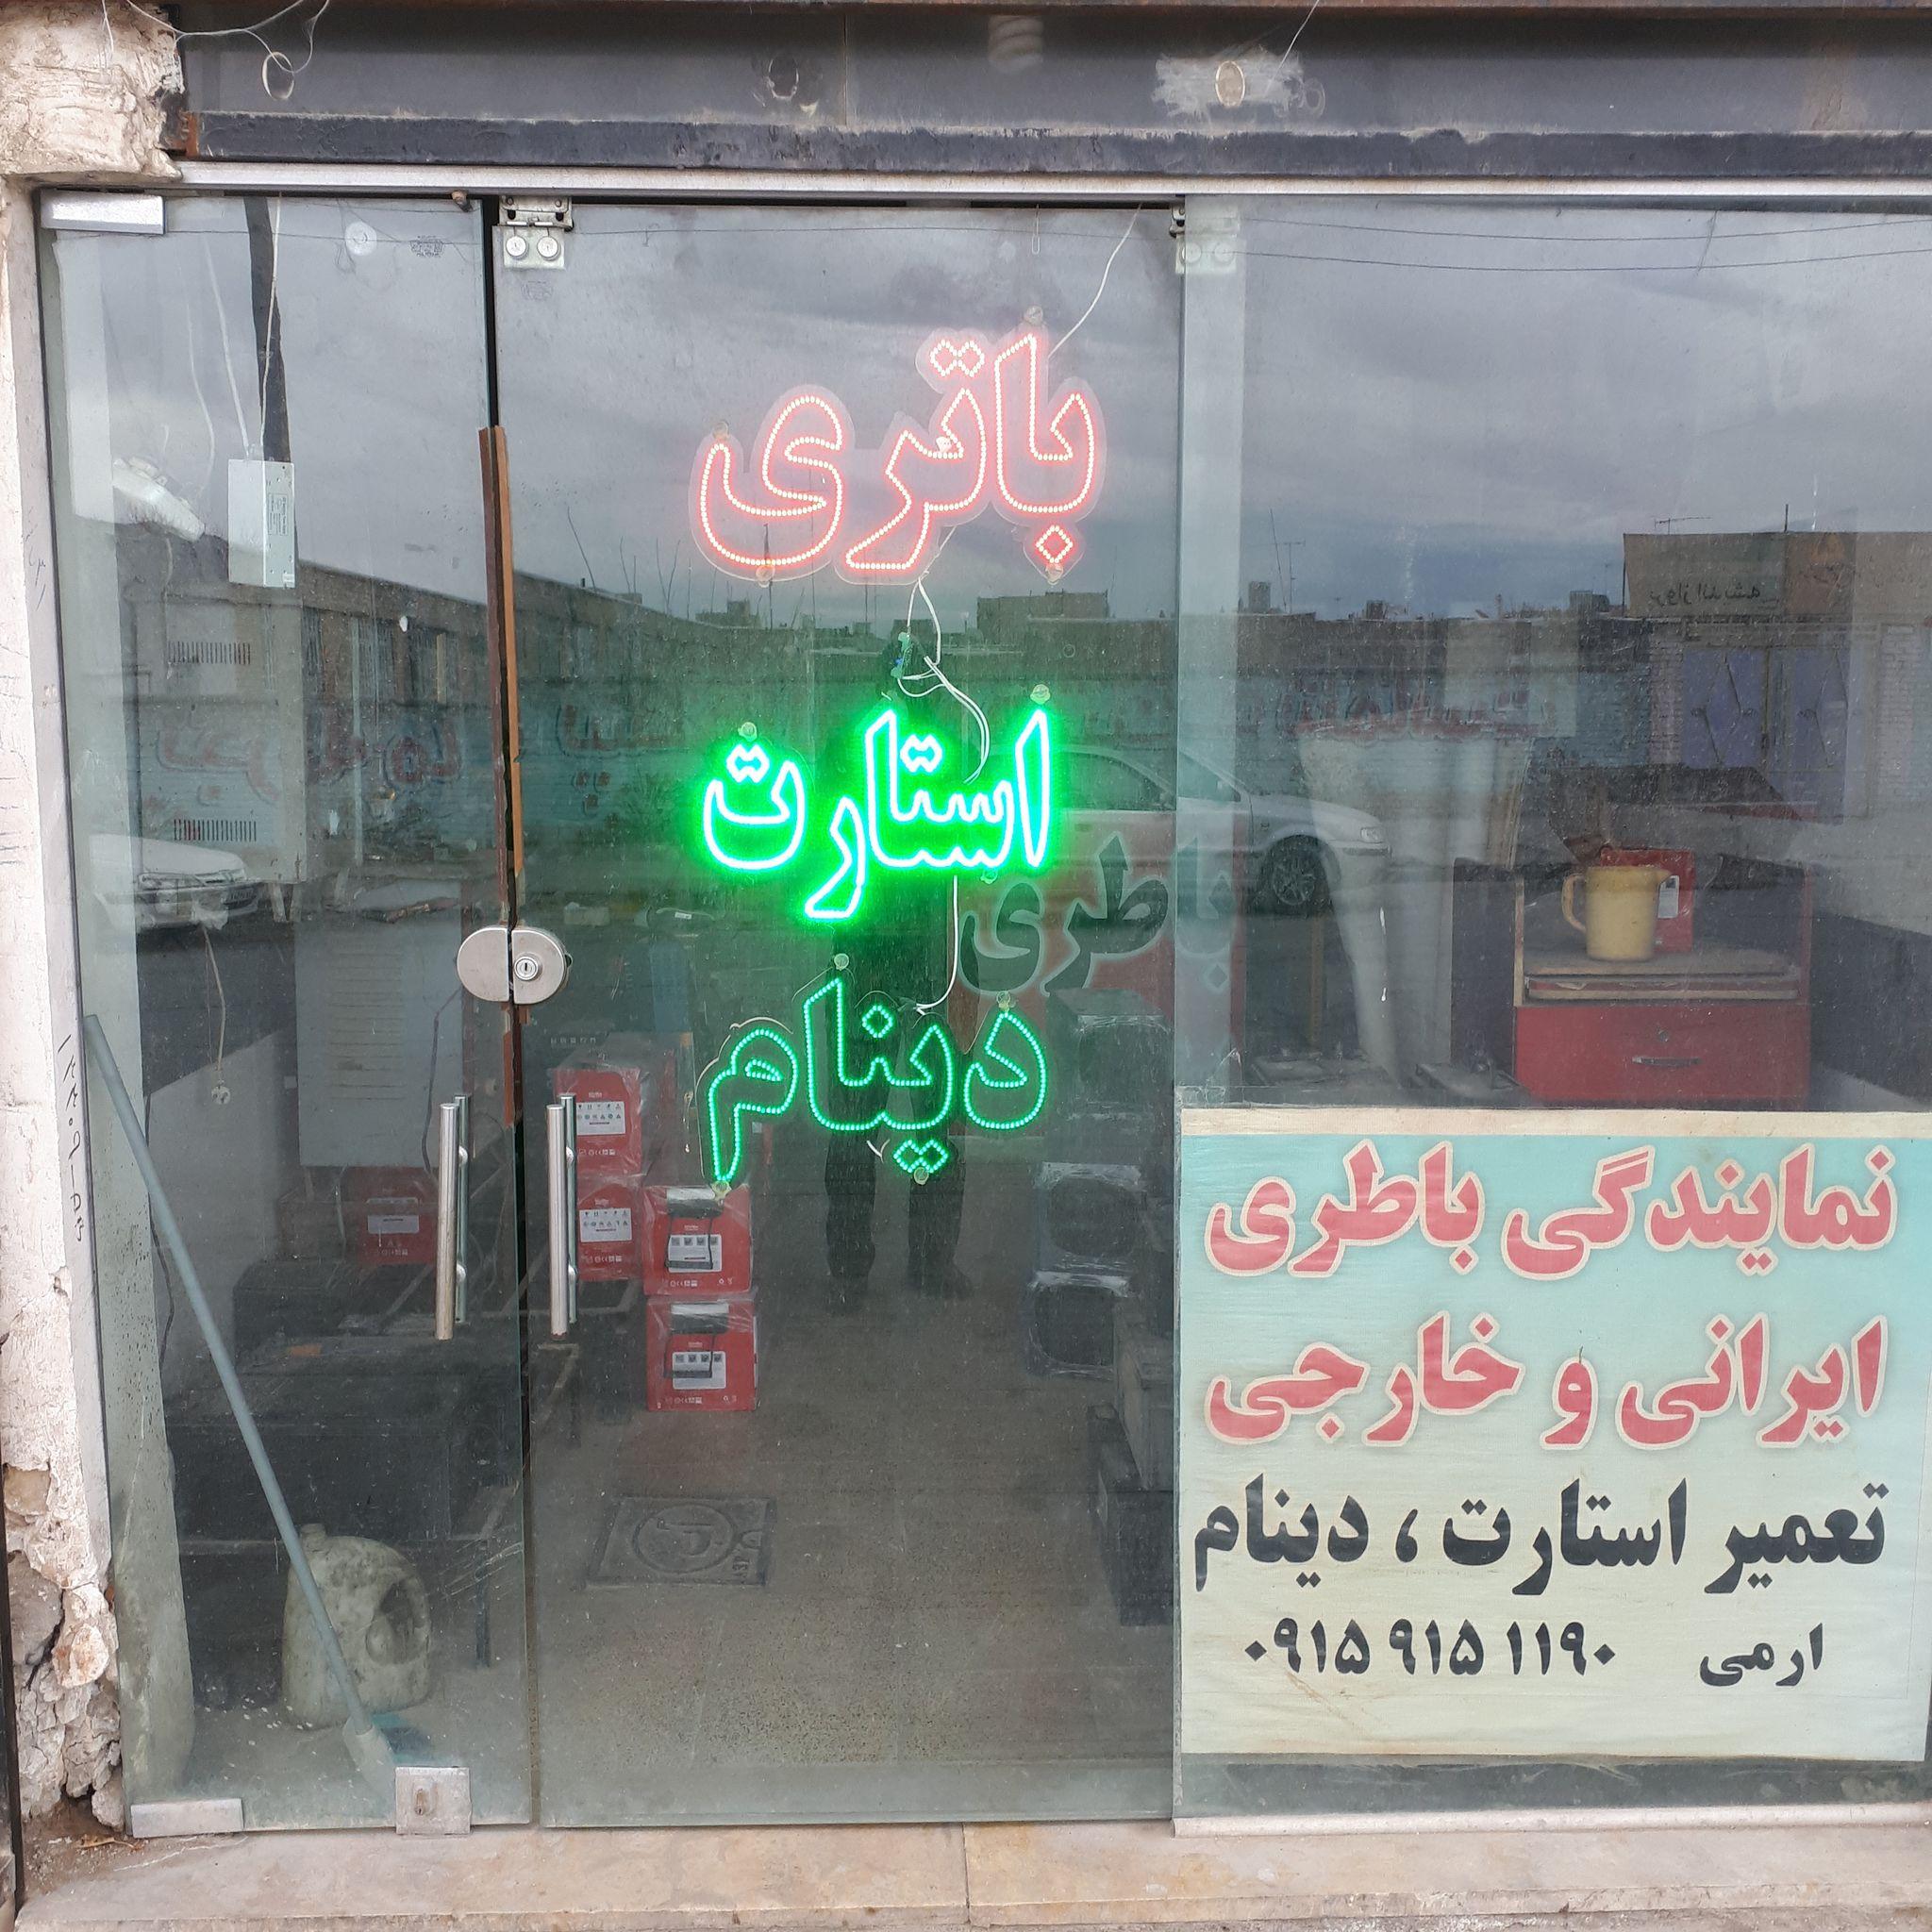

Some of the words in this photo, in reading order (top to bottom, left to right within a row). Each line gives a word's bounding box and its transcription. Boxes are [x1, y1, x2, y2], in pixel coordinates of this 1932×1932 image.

[697, 334, 1097, 573] باتری
[703, 708, 1051, 921] استارت
[708, 977, 1048, 1183] دینام
[1208, 1143, 1483, 1274] باطری
[1507, 1145, 1894, 1276] نمایندگی
[1208, 1315, 1522, 1442] خارجی
[1543, 1358, 1595, 1445] و
[1620, 1318, 1884, 1445] ایرانی
[1195, 1474, 1370, 1591] دینام
[1443, 1478, 1687, 1596] استارت
[1705, 1483, 1889, 1594] تعمیر
[1699, 1623, 1823, 1687] ارمی
